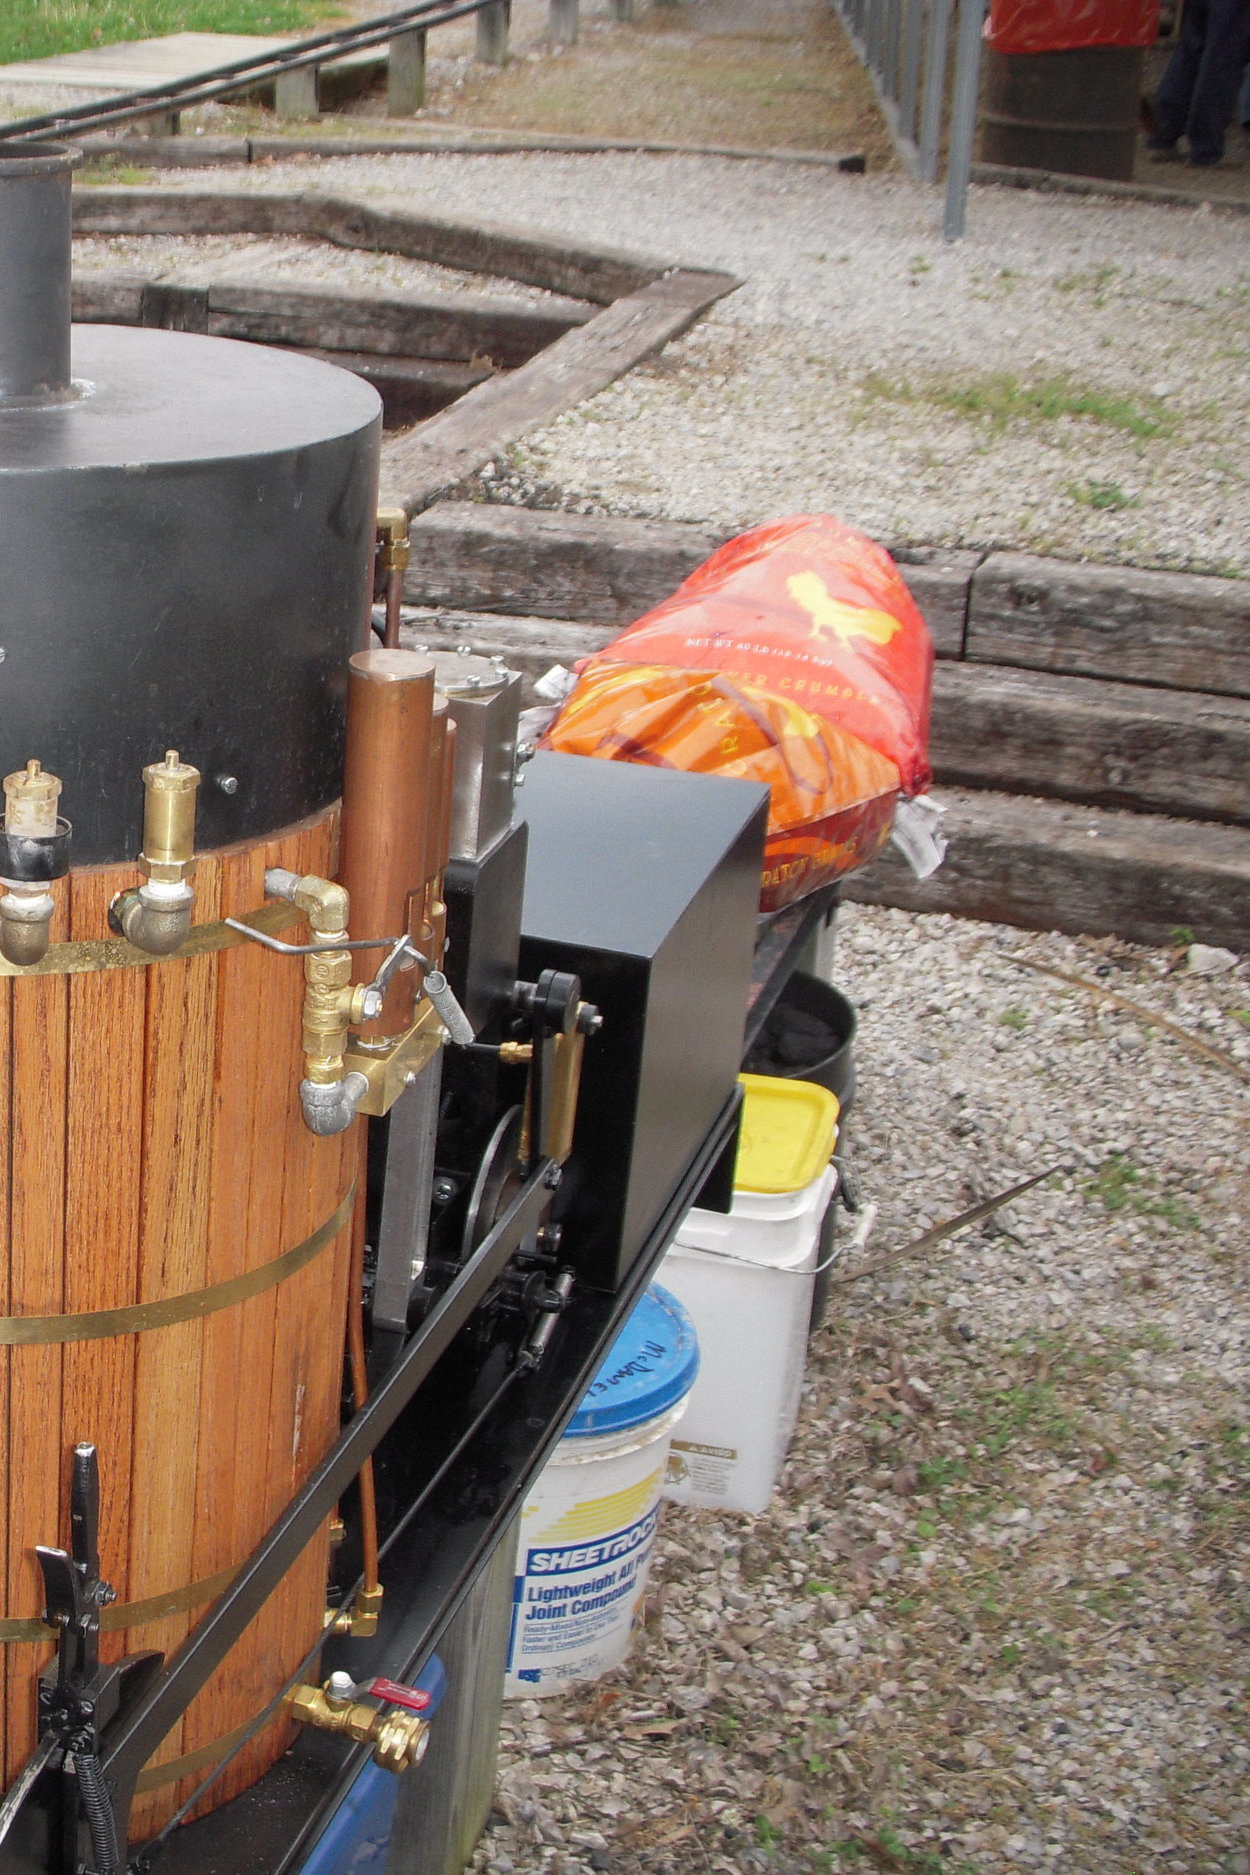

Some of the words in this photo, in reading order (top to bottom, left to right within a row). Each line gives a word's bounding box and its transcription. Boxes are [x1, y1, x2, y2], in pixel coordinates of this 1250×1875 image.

[685, 637, 711, 647] NET
[713, 638, 734, 649] WT
[527, 1570, 617, 1603] Lightweight
[618, 1559, 635, 1578] All
[525, 1602, 567, 1620] Joint
